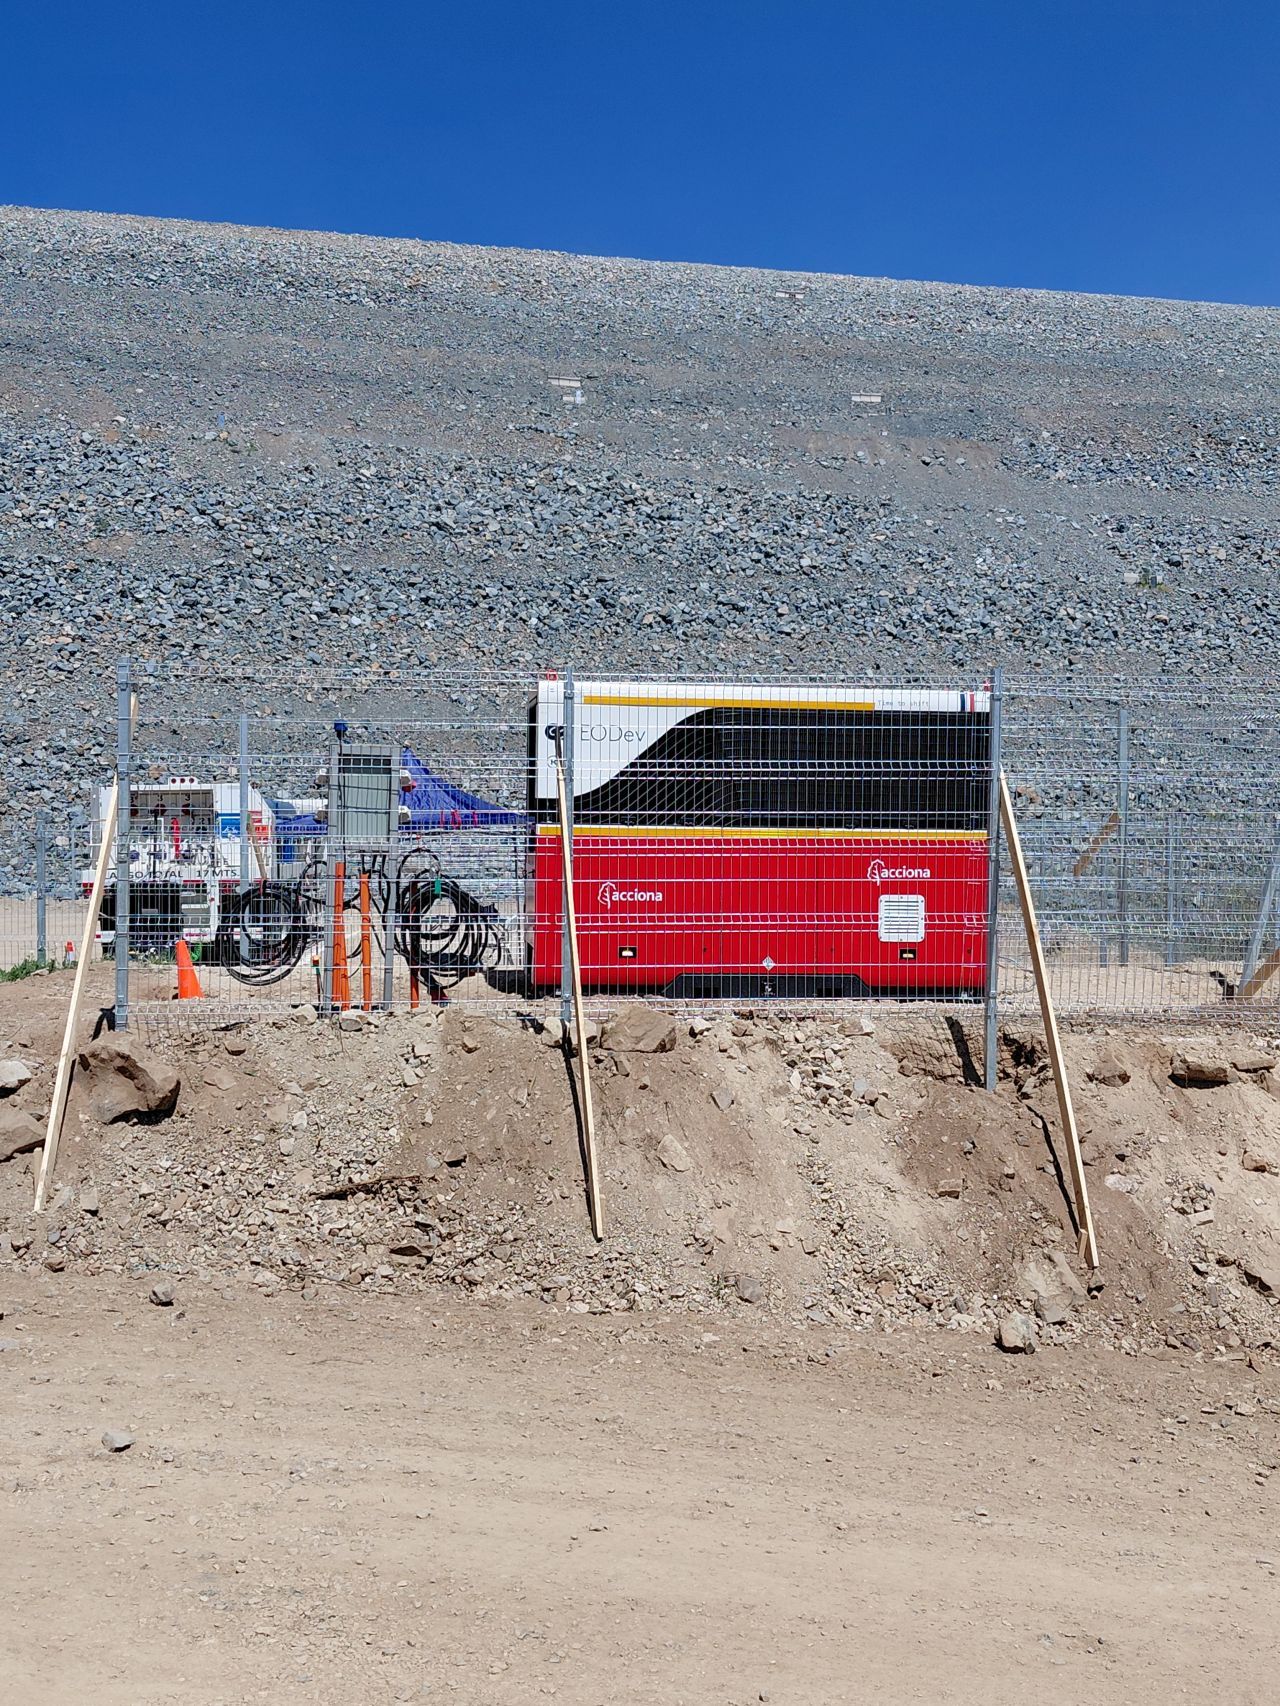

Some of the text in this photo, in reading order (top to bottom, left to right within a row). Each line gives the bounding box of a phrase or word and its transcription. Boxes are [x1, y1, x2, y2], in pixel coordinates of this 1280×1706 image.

[580, 723, 646, 743] EODev
[196, 869, 209, 878] 17
[880, 865, 932, 879] acciona
[611, 887, 663, 902] acciona
